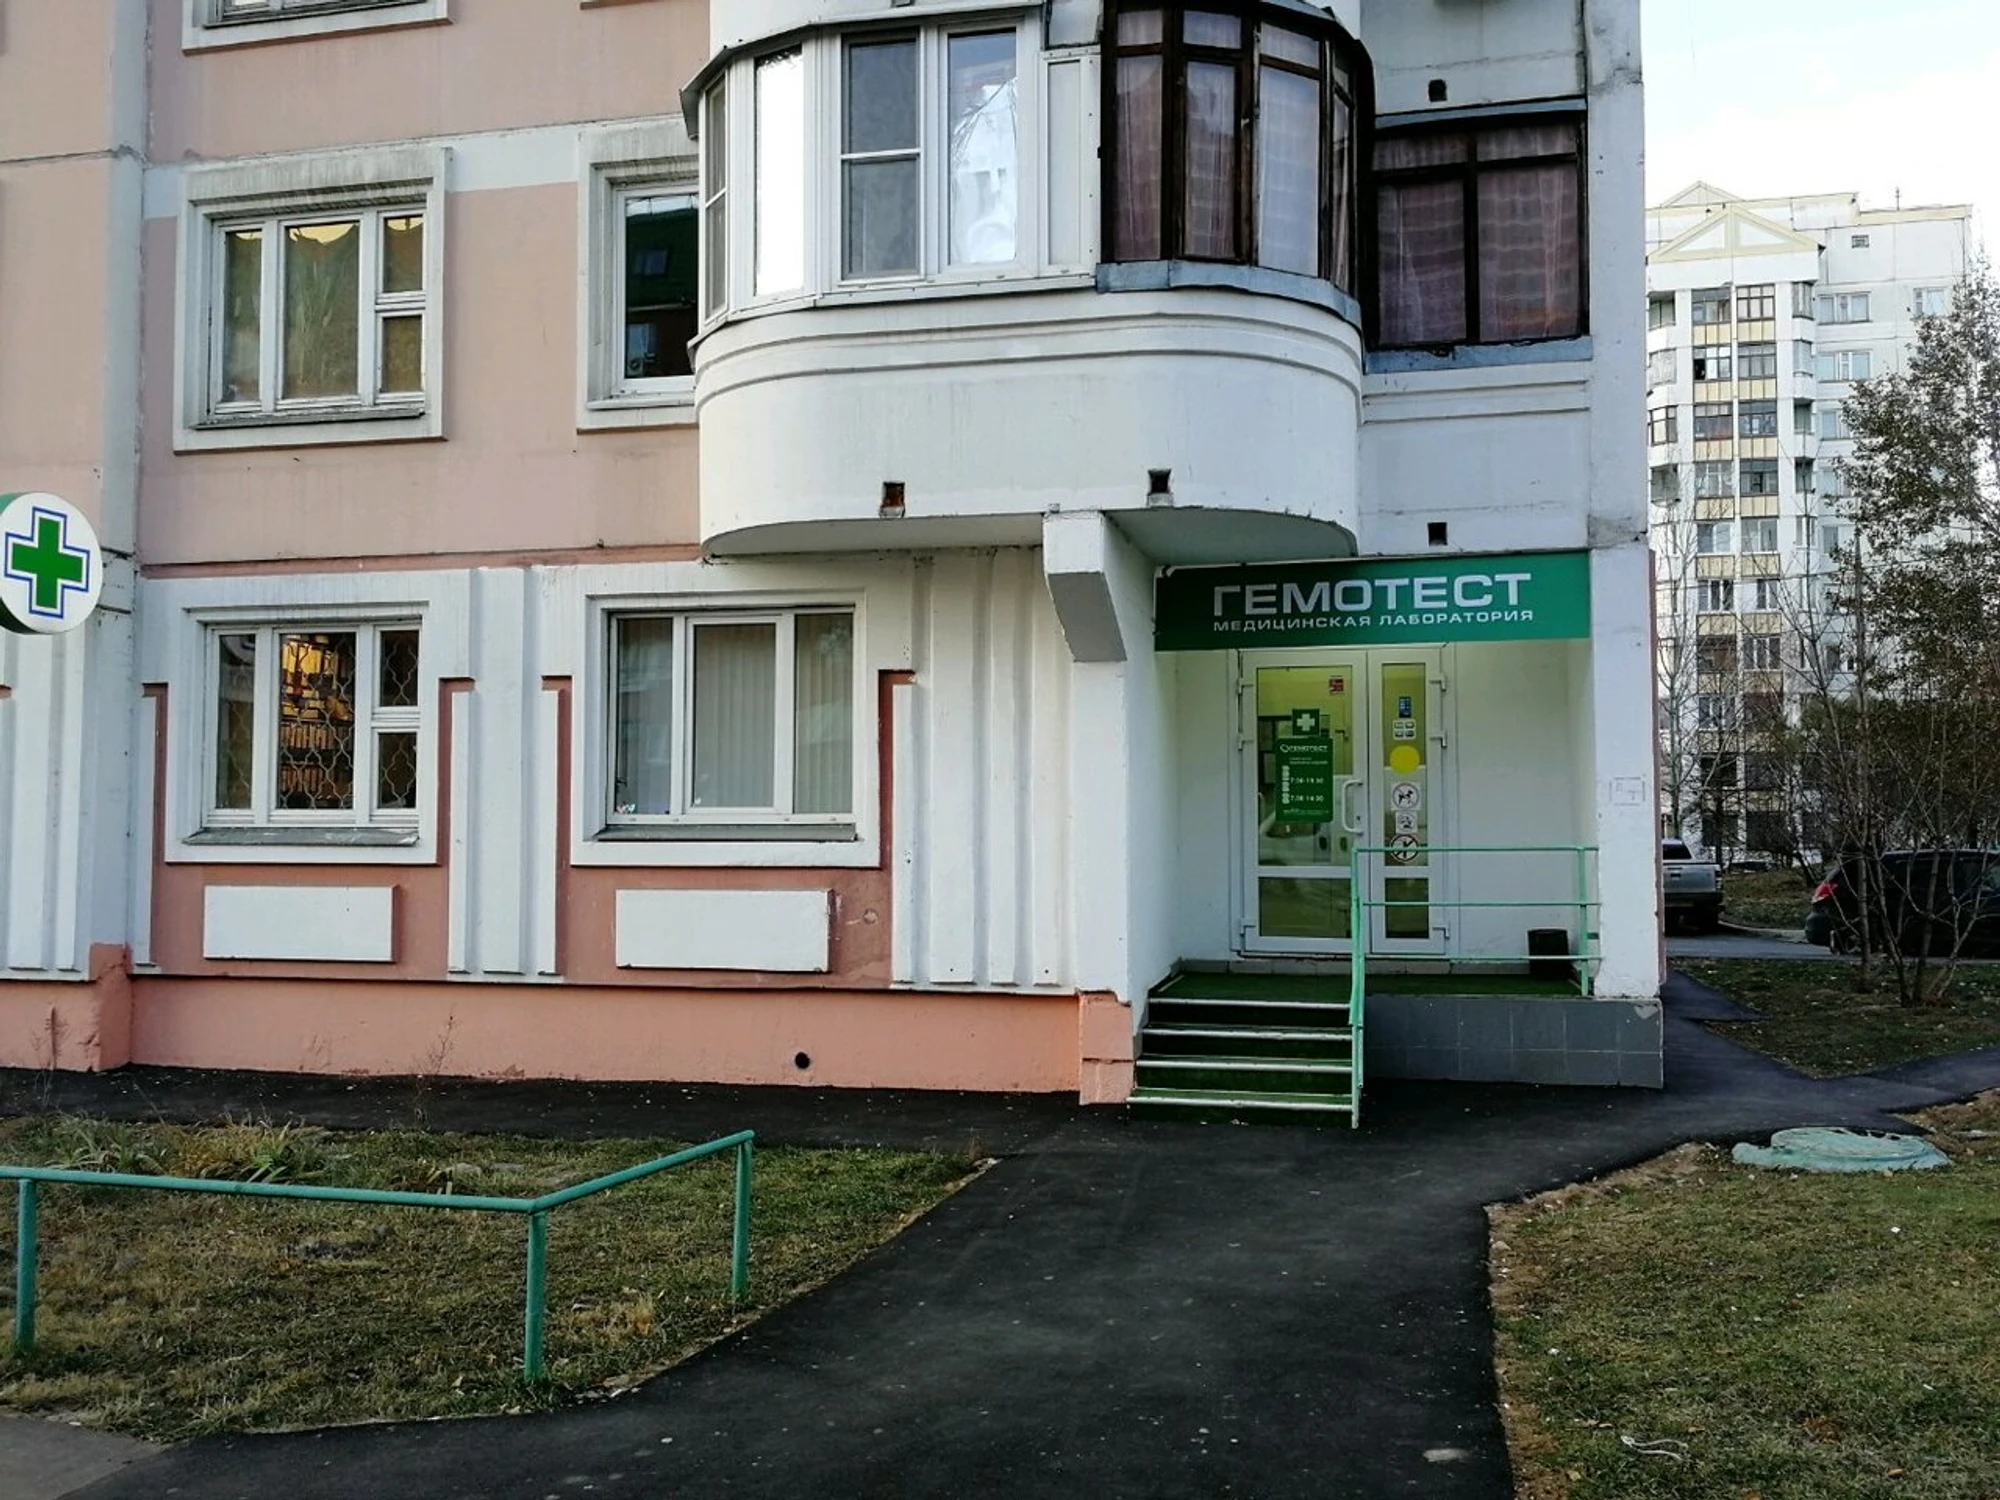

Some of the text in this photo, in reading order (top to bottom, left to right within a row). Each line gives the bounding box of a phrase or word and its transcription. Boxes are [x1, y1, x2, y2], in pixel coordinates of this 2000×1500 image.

[1214, 573, 1532, 617] ГЕМОТЕСТ
[1214, 610, 1533, 632] МЕДИЦИНСКАЯ ЛАБОРАТОРИЯ
